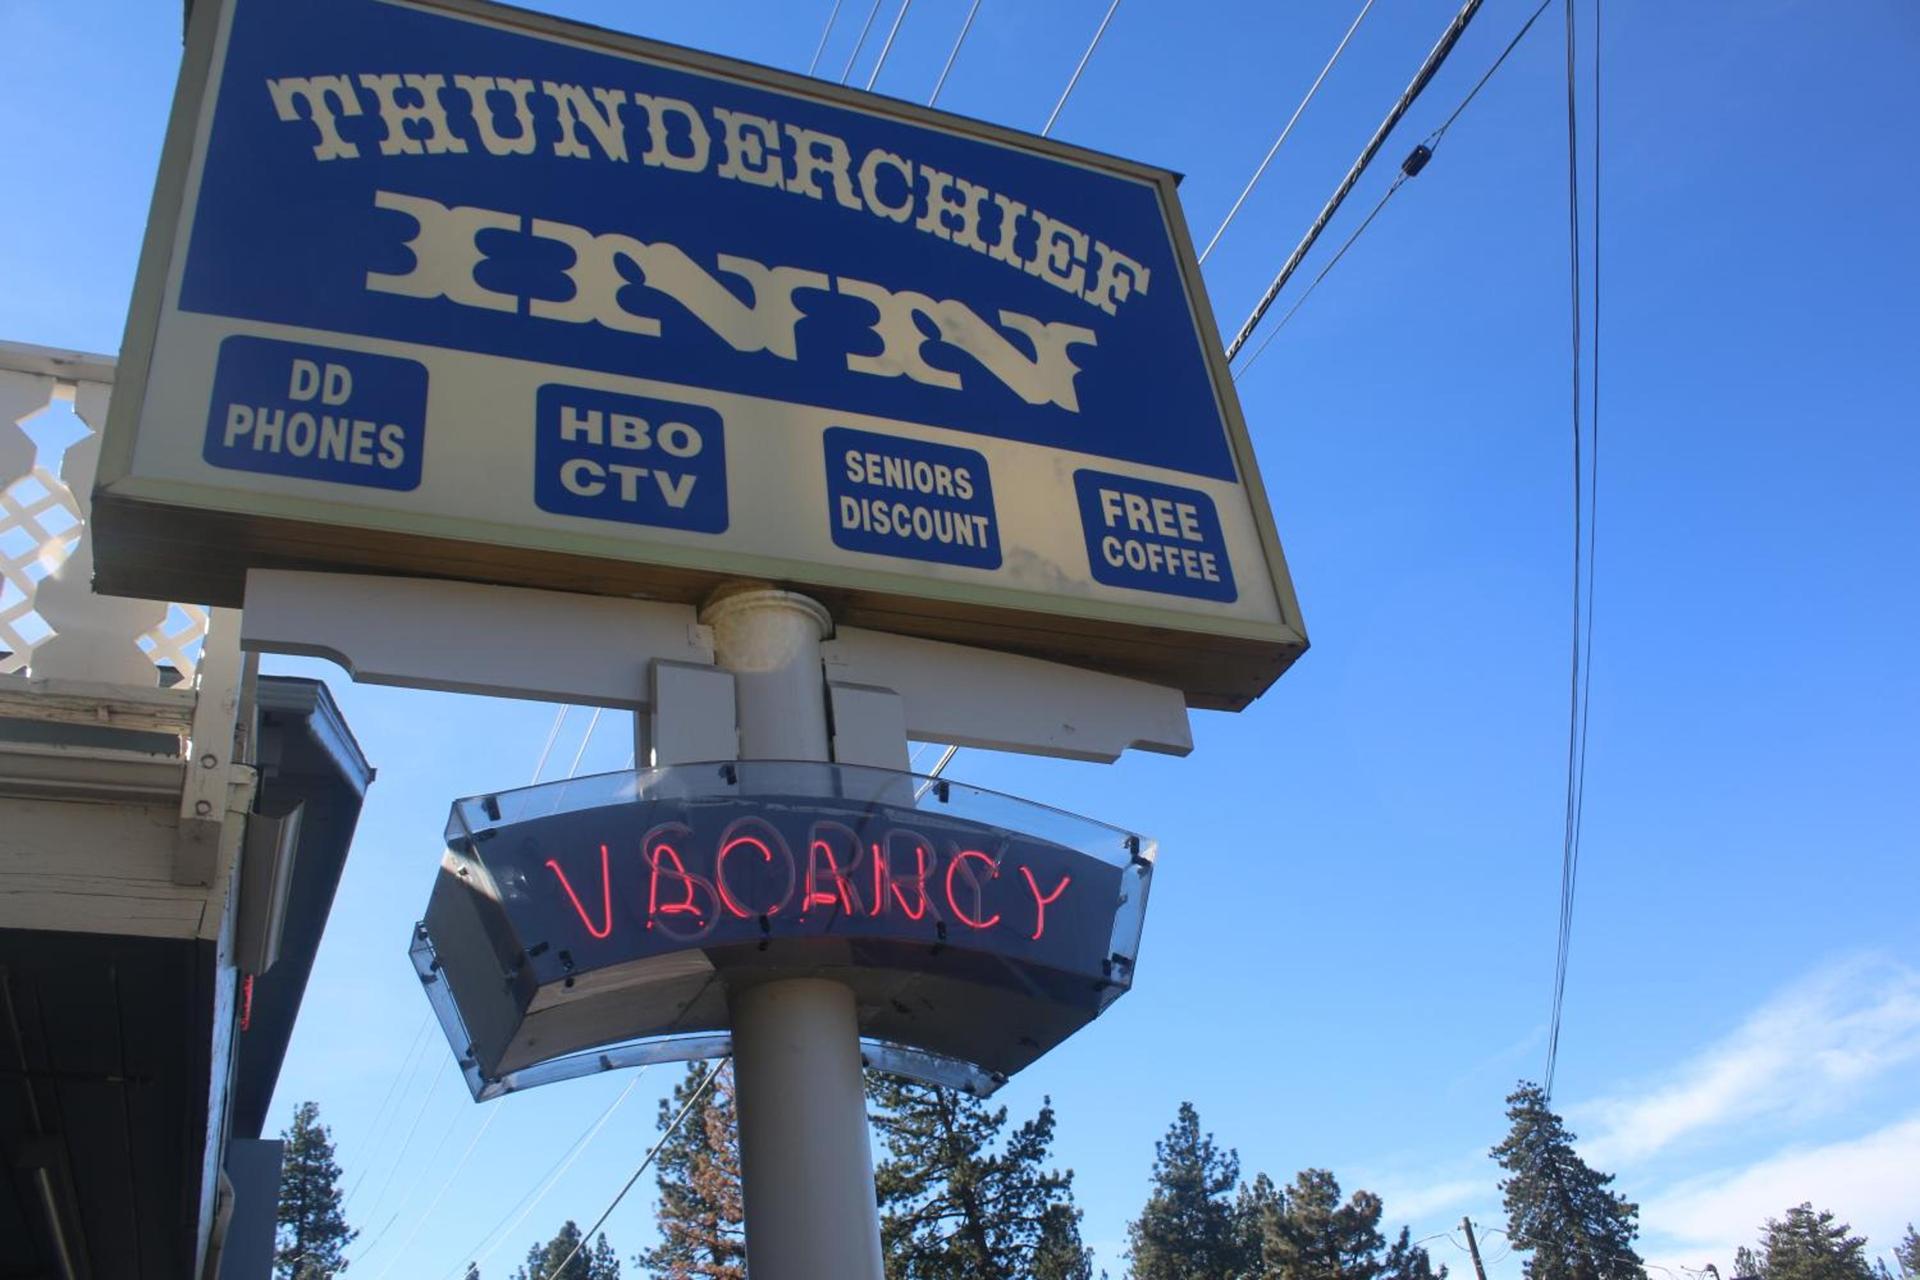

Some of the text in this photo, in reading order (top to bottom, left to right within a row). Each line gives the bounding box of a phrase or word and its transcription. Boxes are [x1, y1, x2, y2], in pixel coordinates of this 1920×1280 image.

[266, 74, 1150, 315] THUNDERCHIEF
[366, 190, 1097, 413] INN
[289, 358, 352, 405] DD
[223, 404, 405, 469] PHONES
[560, 406, 703, 458] HBO
[559, 459, 697, 509] CTV
[845, 449, 973, 500] SENIORS
[839, 496, 989, 548] DISCOUNT
[1099, 488, 1203, 542] FREE
[1102, 535, 1221, 582] COFFEE
[545, 837, 1071, 940] VACANCY
